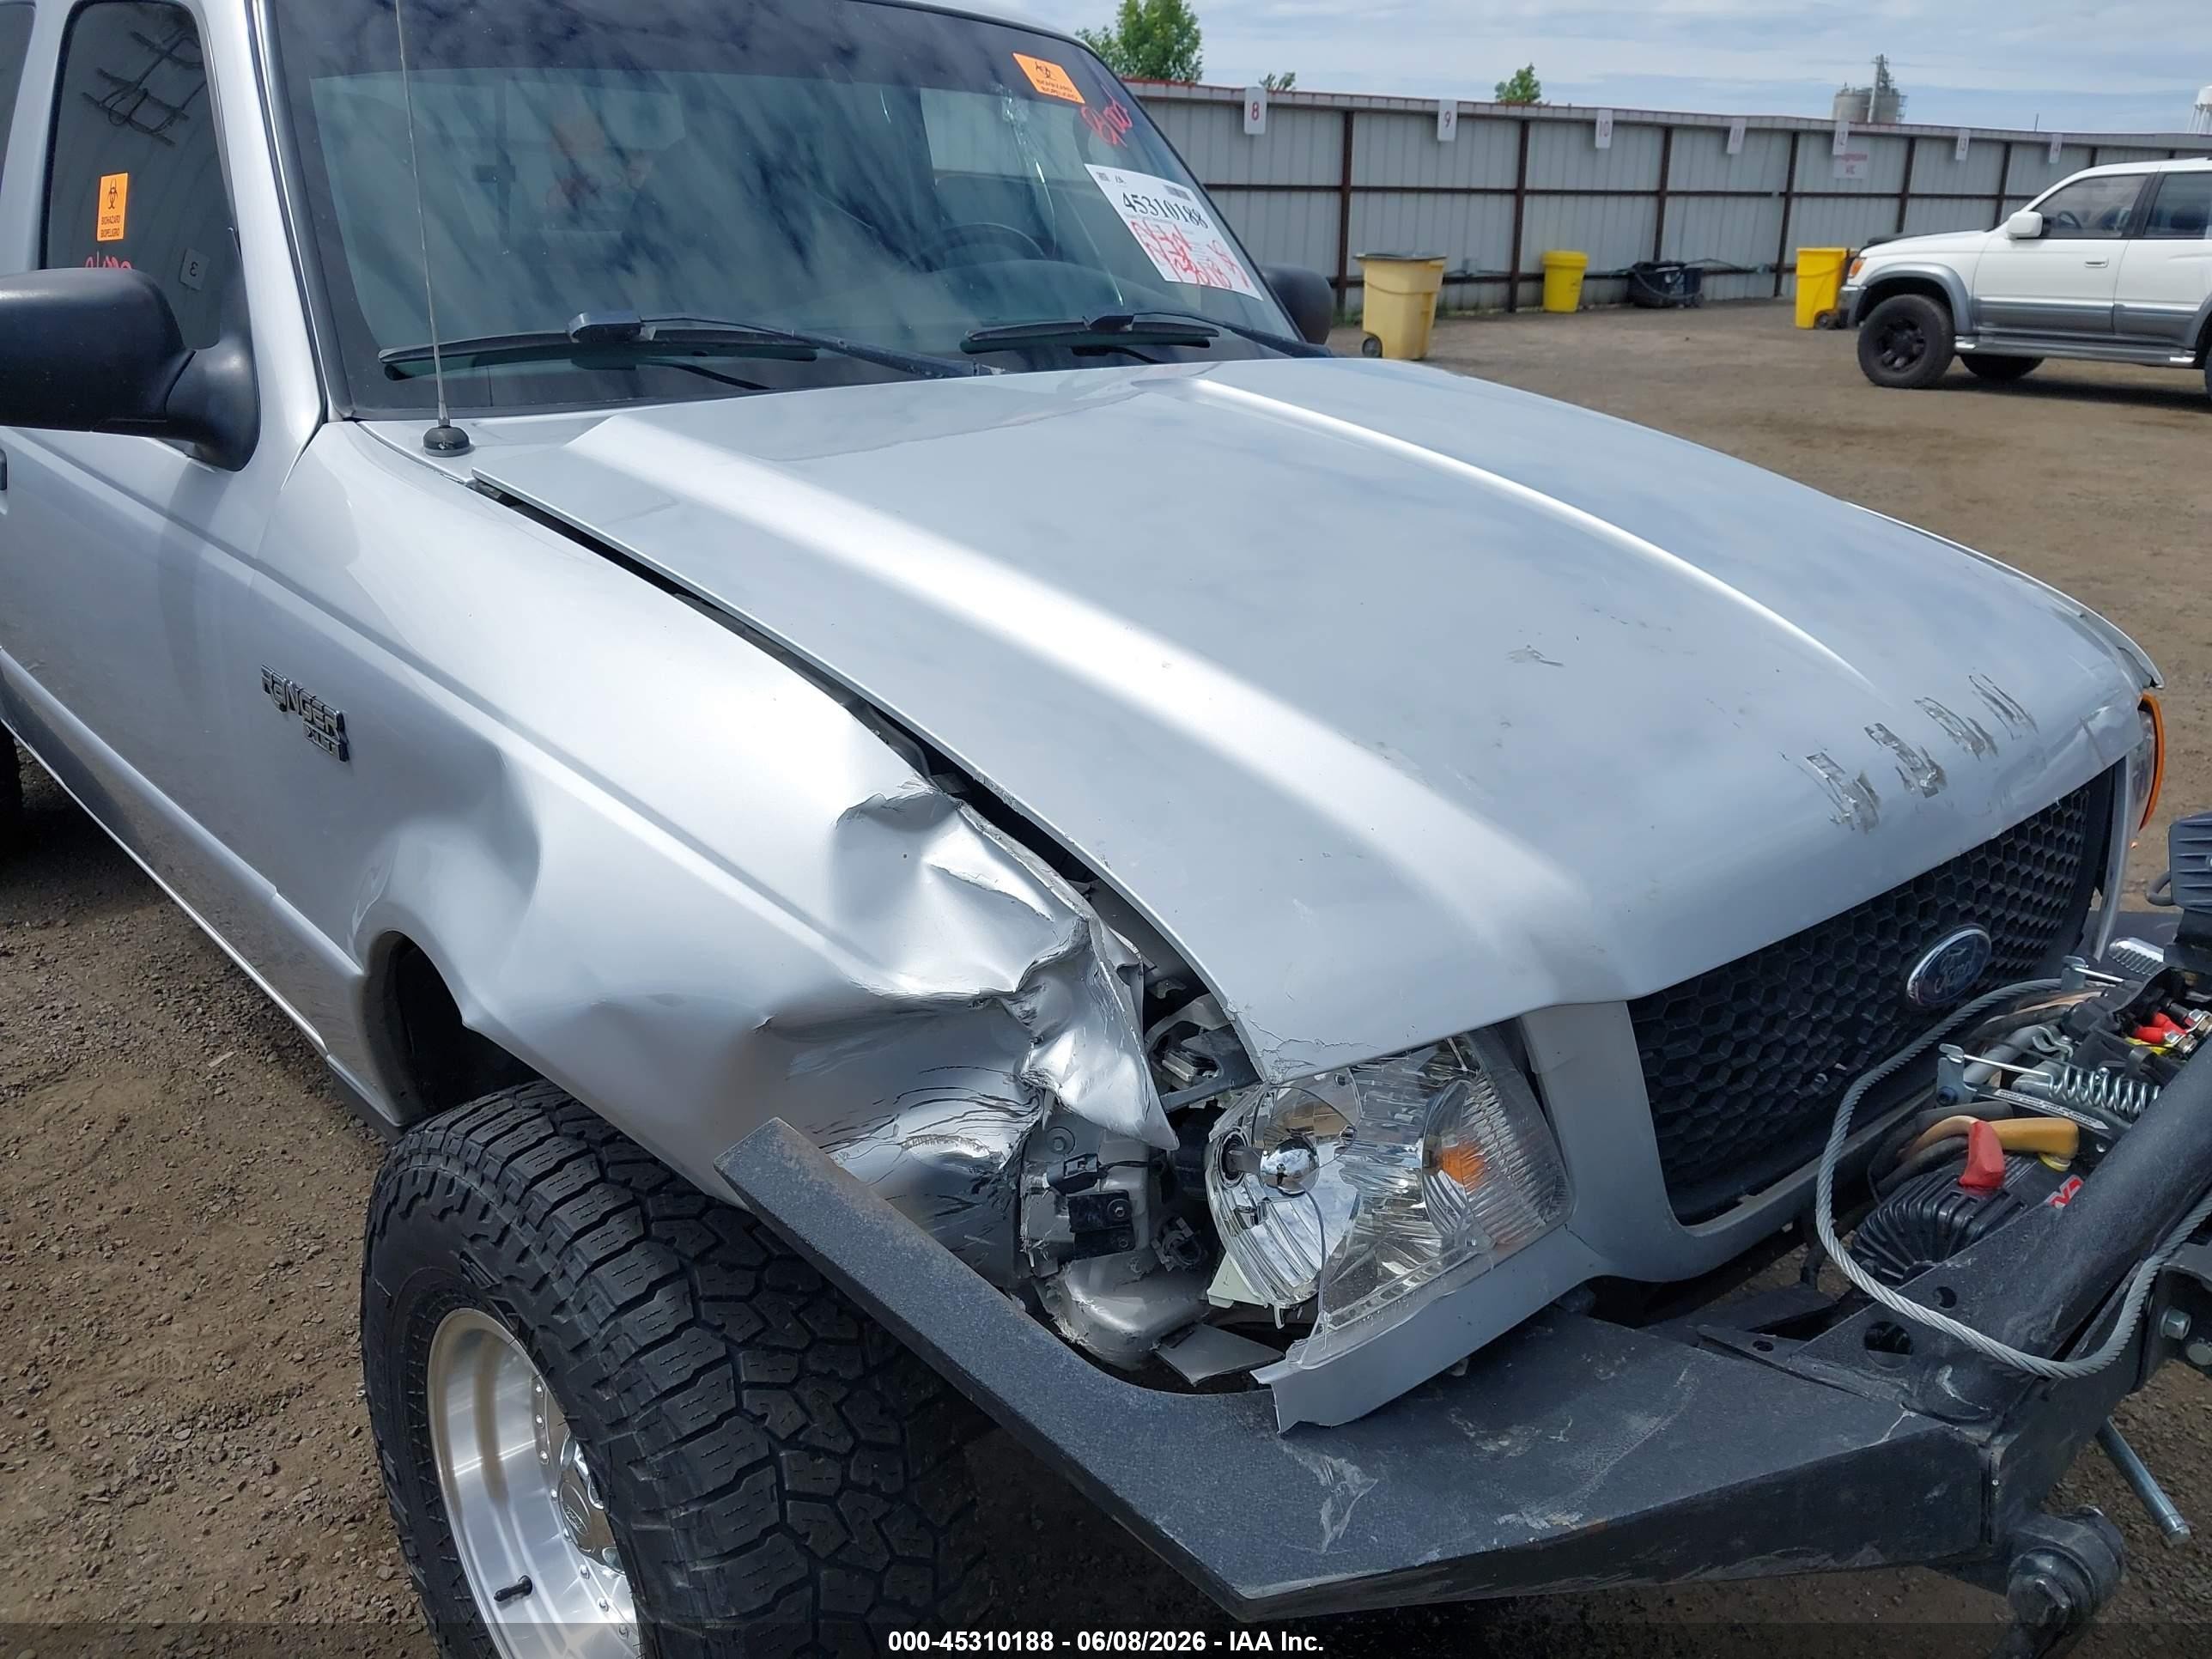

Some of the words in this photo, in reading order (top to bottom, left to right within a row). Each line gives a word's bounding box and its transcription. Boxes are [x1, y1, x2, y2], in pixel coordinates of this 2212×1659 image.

[1251, 101, 1260, 121] 8
[1444, 110, 1452, 129] 9
[1599, 120, 1609, 137] 10
[1122, 191, 1209, 229] 45310188
[260, 664, 344, 742] RANGER
[303, 723, 345, 759] XLT
[1934, 945, 1974, 994] Ford
